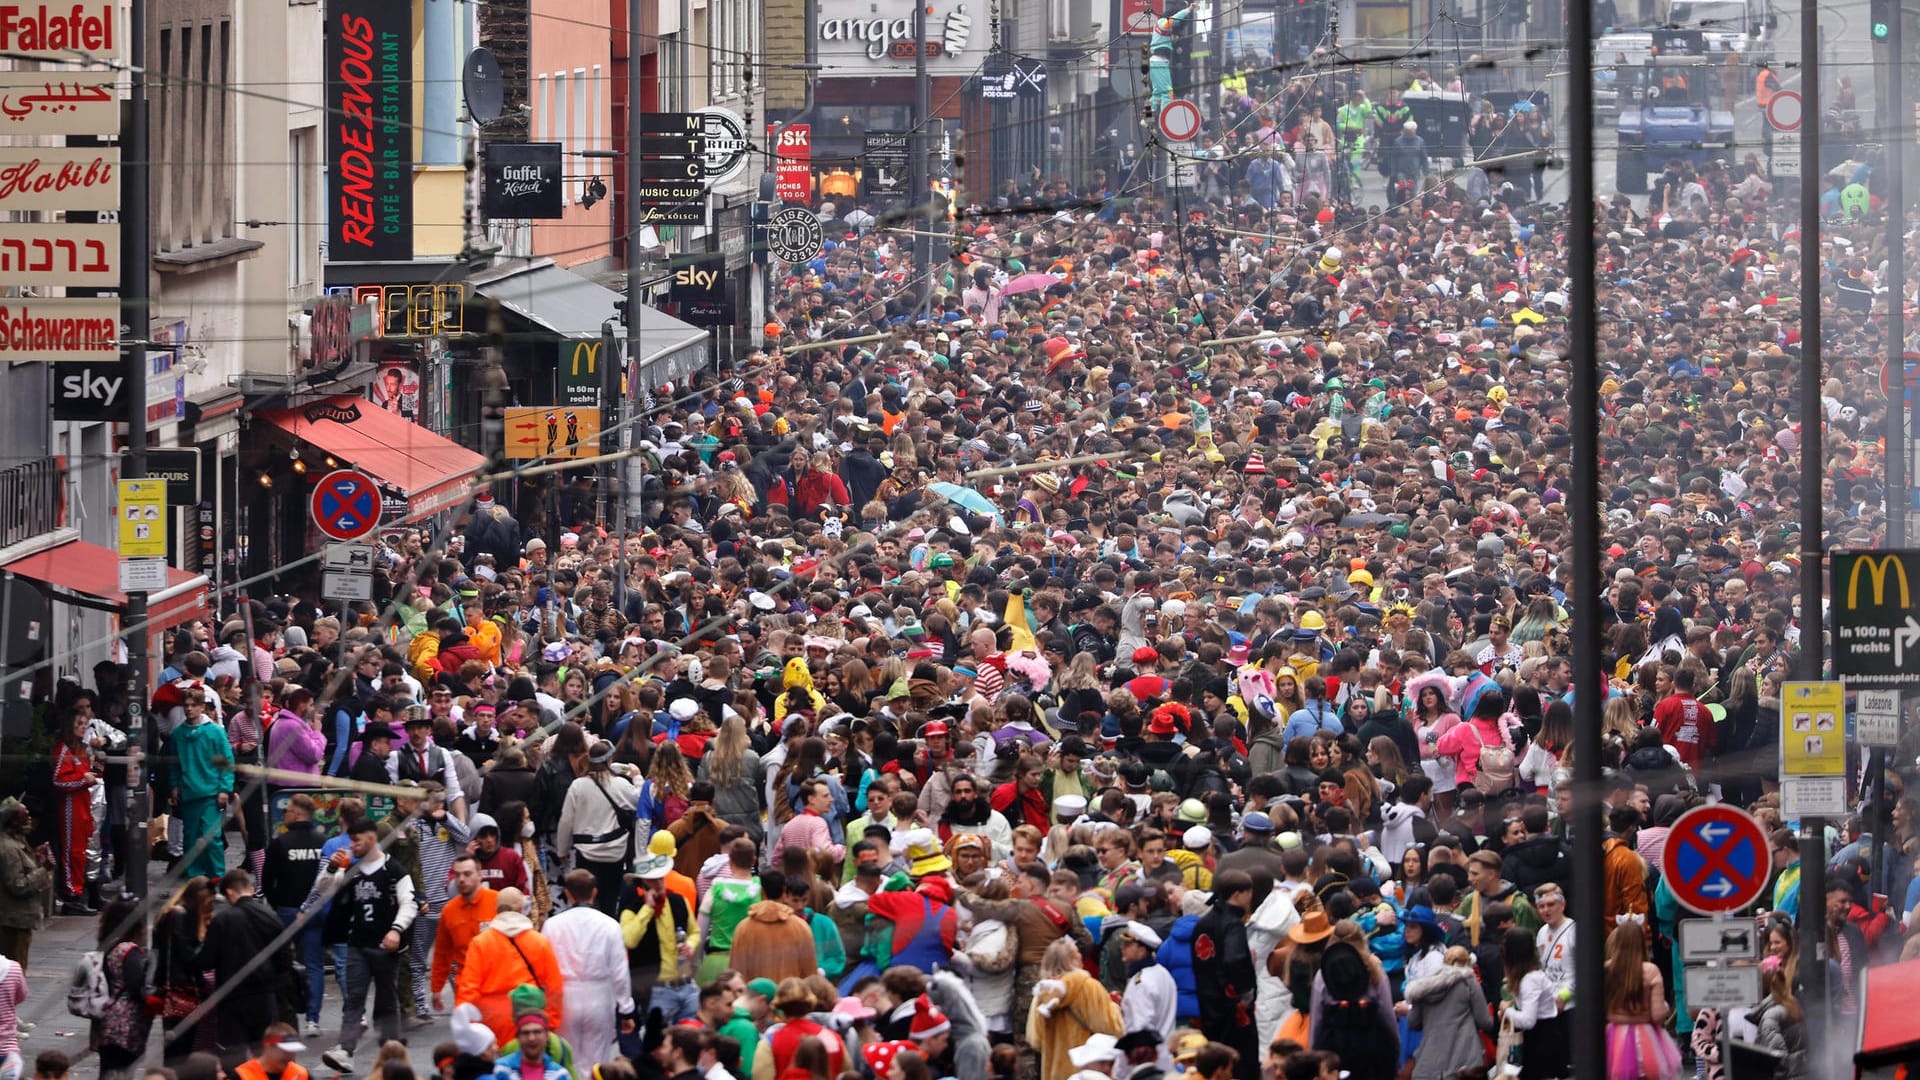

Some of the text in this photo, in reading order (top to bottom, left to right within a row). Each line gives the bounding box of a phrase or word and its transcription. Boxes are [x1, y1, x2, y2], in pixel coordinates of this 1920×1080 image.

[0, 5, 112, 51] Falafel
[2, 82, 112, 121] حبيبي
[340, 13, 374, 247] RENDEZVOUS
[686, 116, 700, 129] M
[381, 32, 400, 234] CAFÉ BAR RESTAURANT
[688, 140, 698, 153] T
[0, 157, 112, 199] Habibi
[503, 165, 542, 181] Gaffel
[687, 163, 699, 177] C
[502, 181, 542, 197] Kölsch
[673, 189, 700, 197] CLUB
[2, 239, 110, 272] ברכה
[771, 241, 818, 262] 9383320
[676, 264, 718, 290] sky
[0, 306, 115, 352] Schawarma
[63, 368, 123, 406] sky
[146, 472, 190, 481] OLOURS
[1840, 626, 1890, 637] in 100 m
[1850, 642, 1891, 653] rechts
[1864, 696, 1893, 711] Ladezone
[288, 849, 322, 860] SWAT
[363, 904, 374, 921] 2
[1553, 944, 1563, 959] 2
